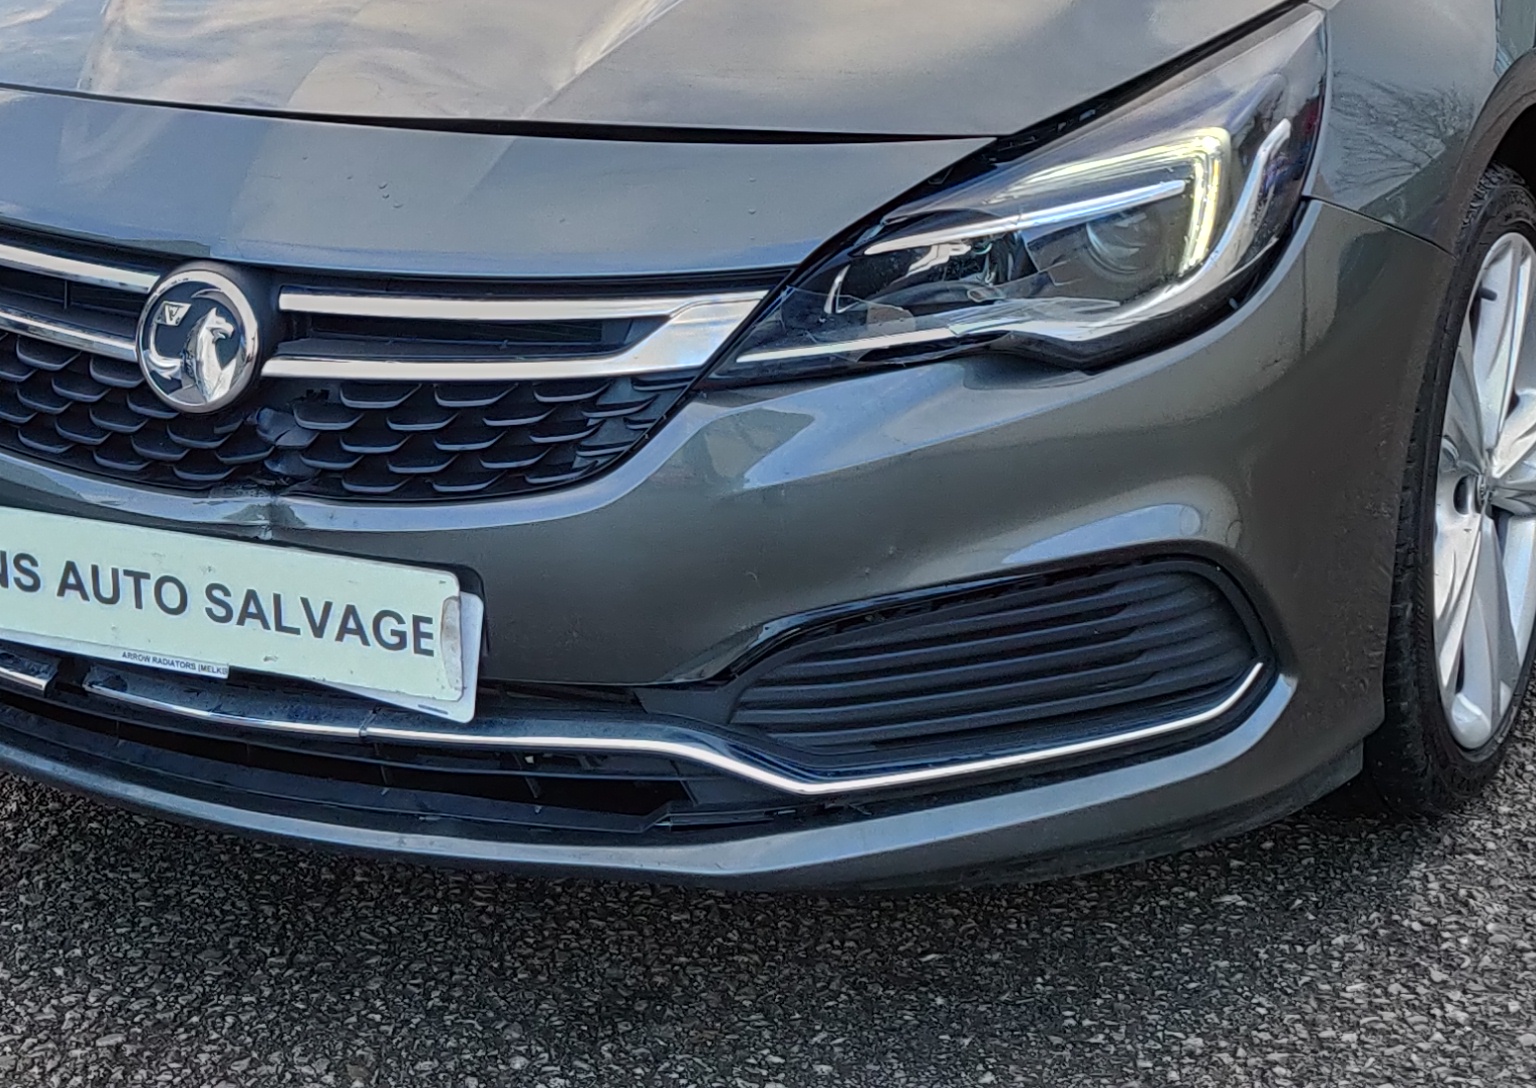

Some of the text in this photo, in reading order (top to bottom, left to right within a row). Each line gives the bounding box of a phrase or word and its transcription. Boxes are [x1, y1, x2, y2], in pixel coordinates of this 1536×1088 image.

[56, 560, 189, 616] AUTO
[204, 582, 435, 657] SALVAGE
[122, 651, 151, 663] ARROW
[152, 656, 196, 670] RADIATORS
